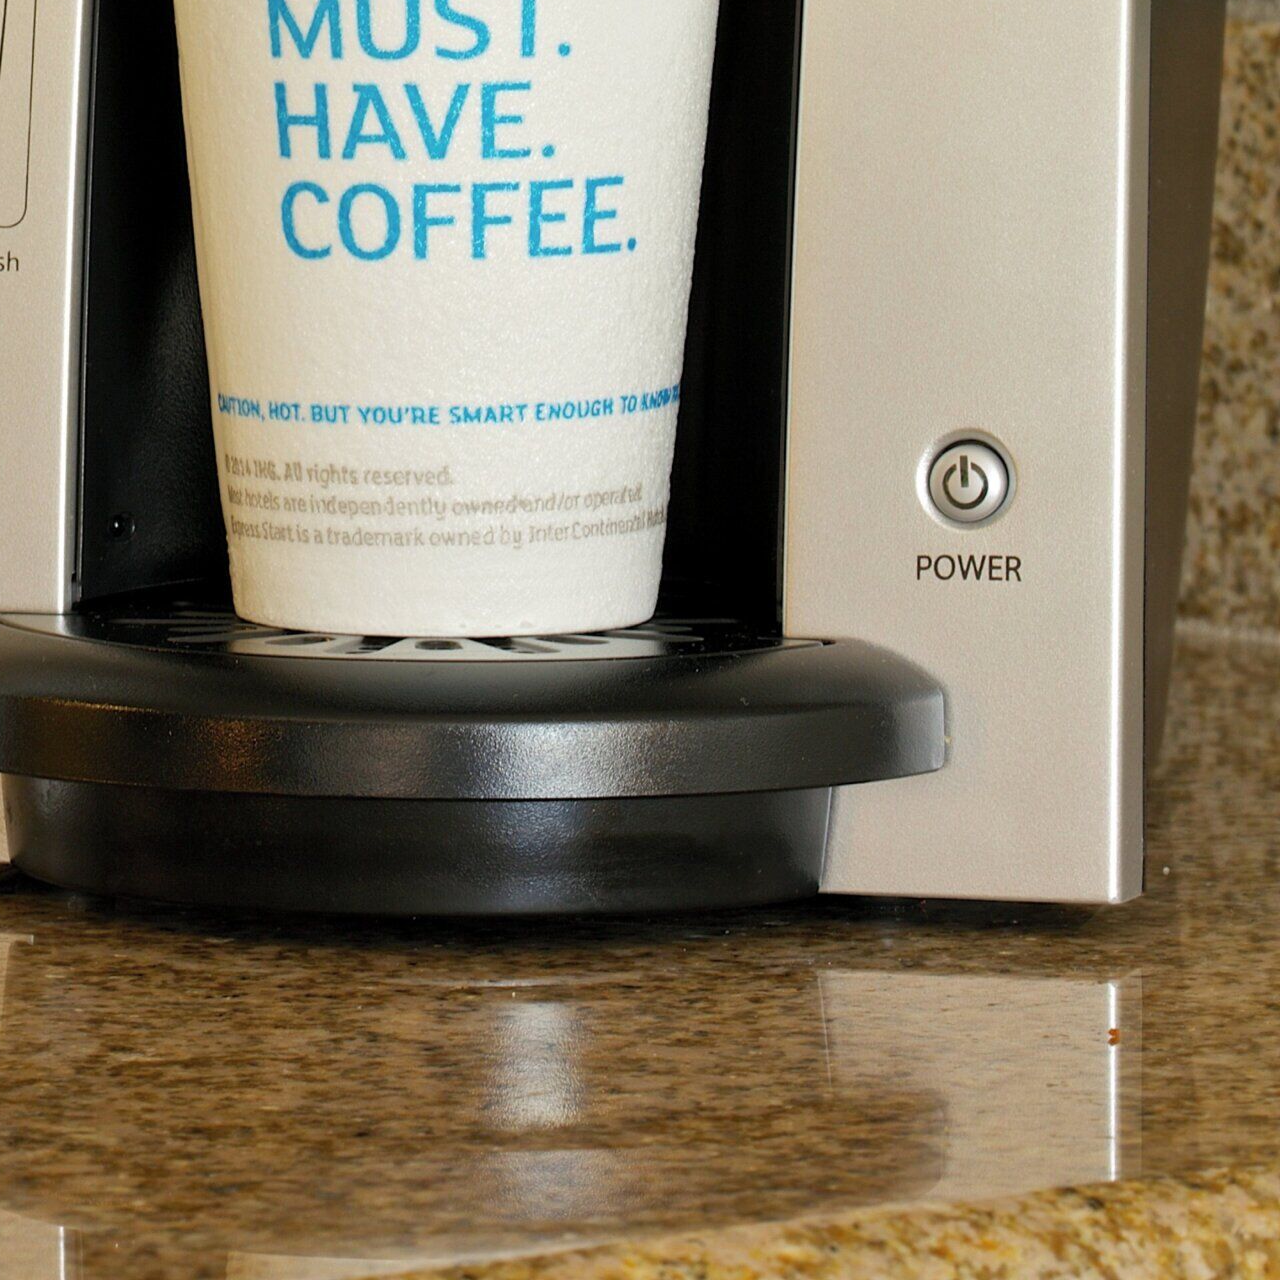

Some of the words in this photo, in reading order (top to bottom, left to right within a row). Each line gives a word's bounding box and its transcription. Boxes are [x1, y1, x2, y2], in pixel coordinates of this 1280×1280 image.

[274, 81, 555, 160] HAVE.
[281, 176, 637, 261] COFFEE.
[269, 403, 306, 420] HOT.
[310, 404, 349, 424] BUT
[449, 404, 528, 424] SMART
[534, 399, 614, 422] ENOUGH
[620, 395, 640, 414] TO
[307, 462, 359, 489] rights
[283, 496, 307, 513] are
[296, 523, 309, 543] is
[326, 527, 425, 547] trademark
[500, 525, 522, 549] by
[917, 555, 1021, 581] POWER
